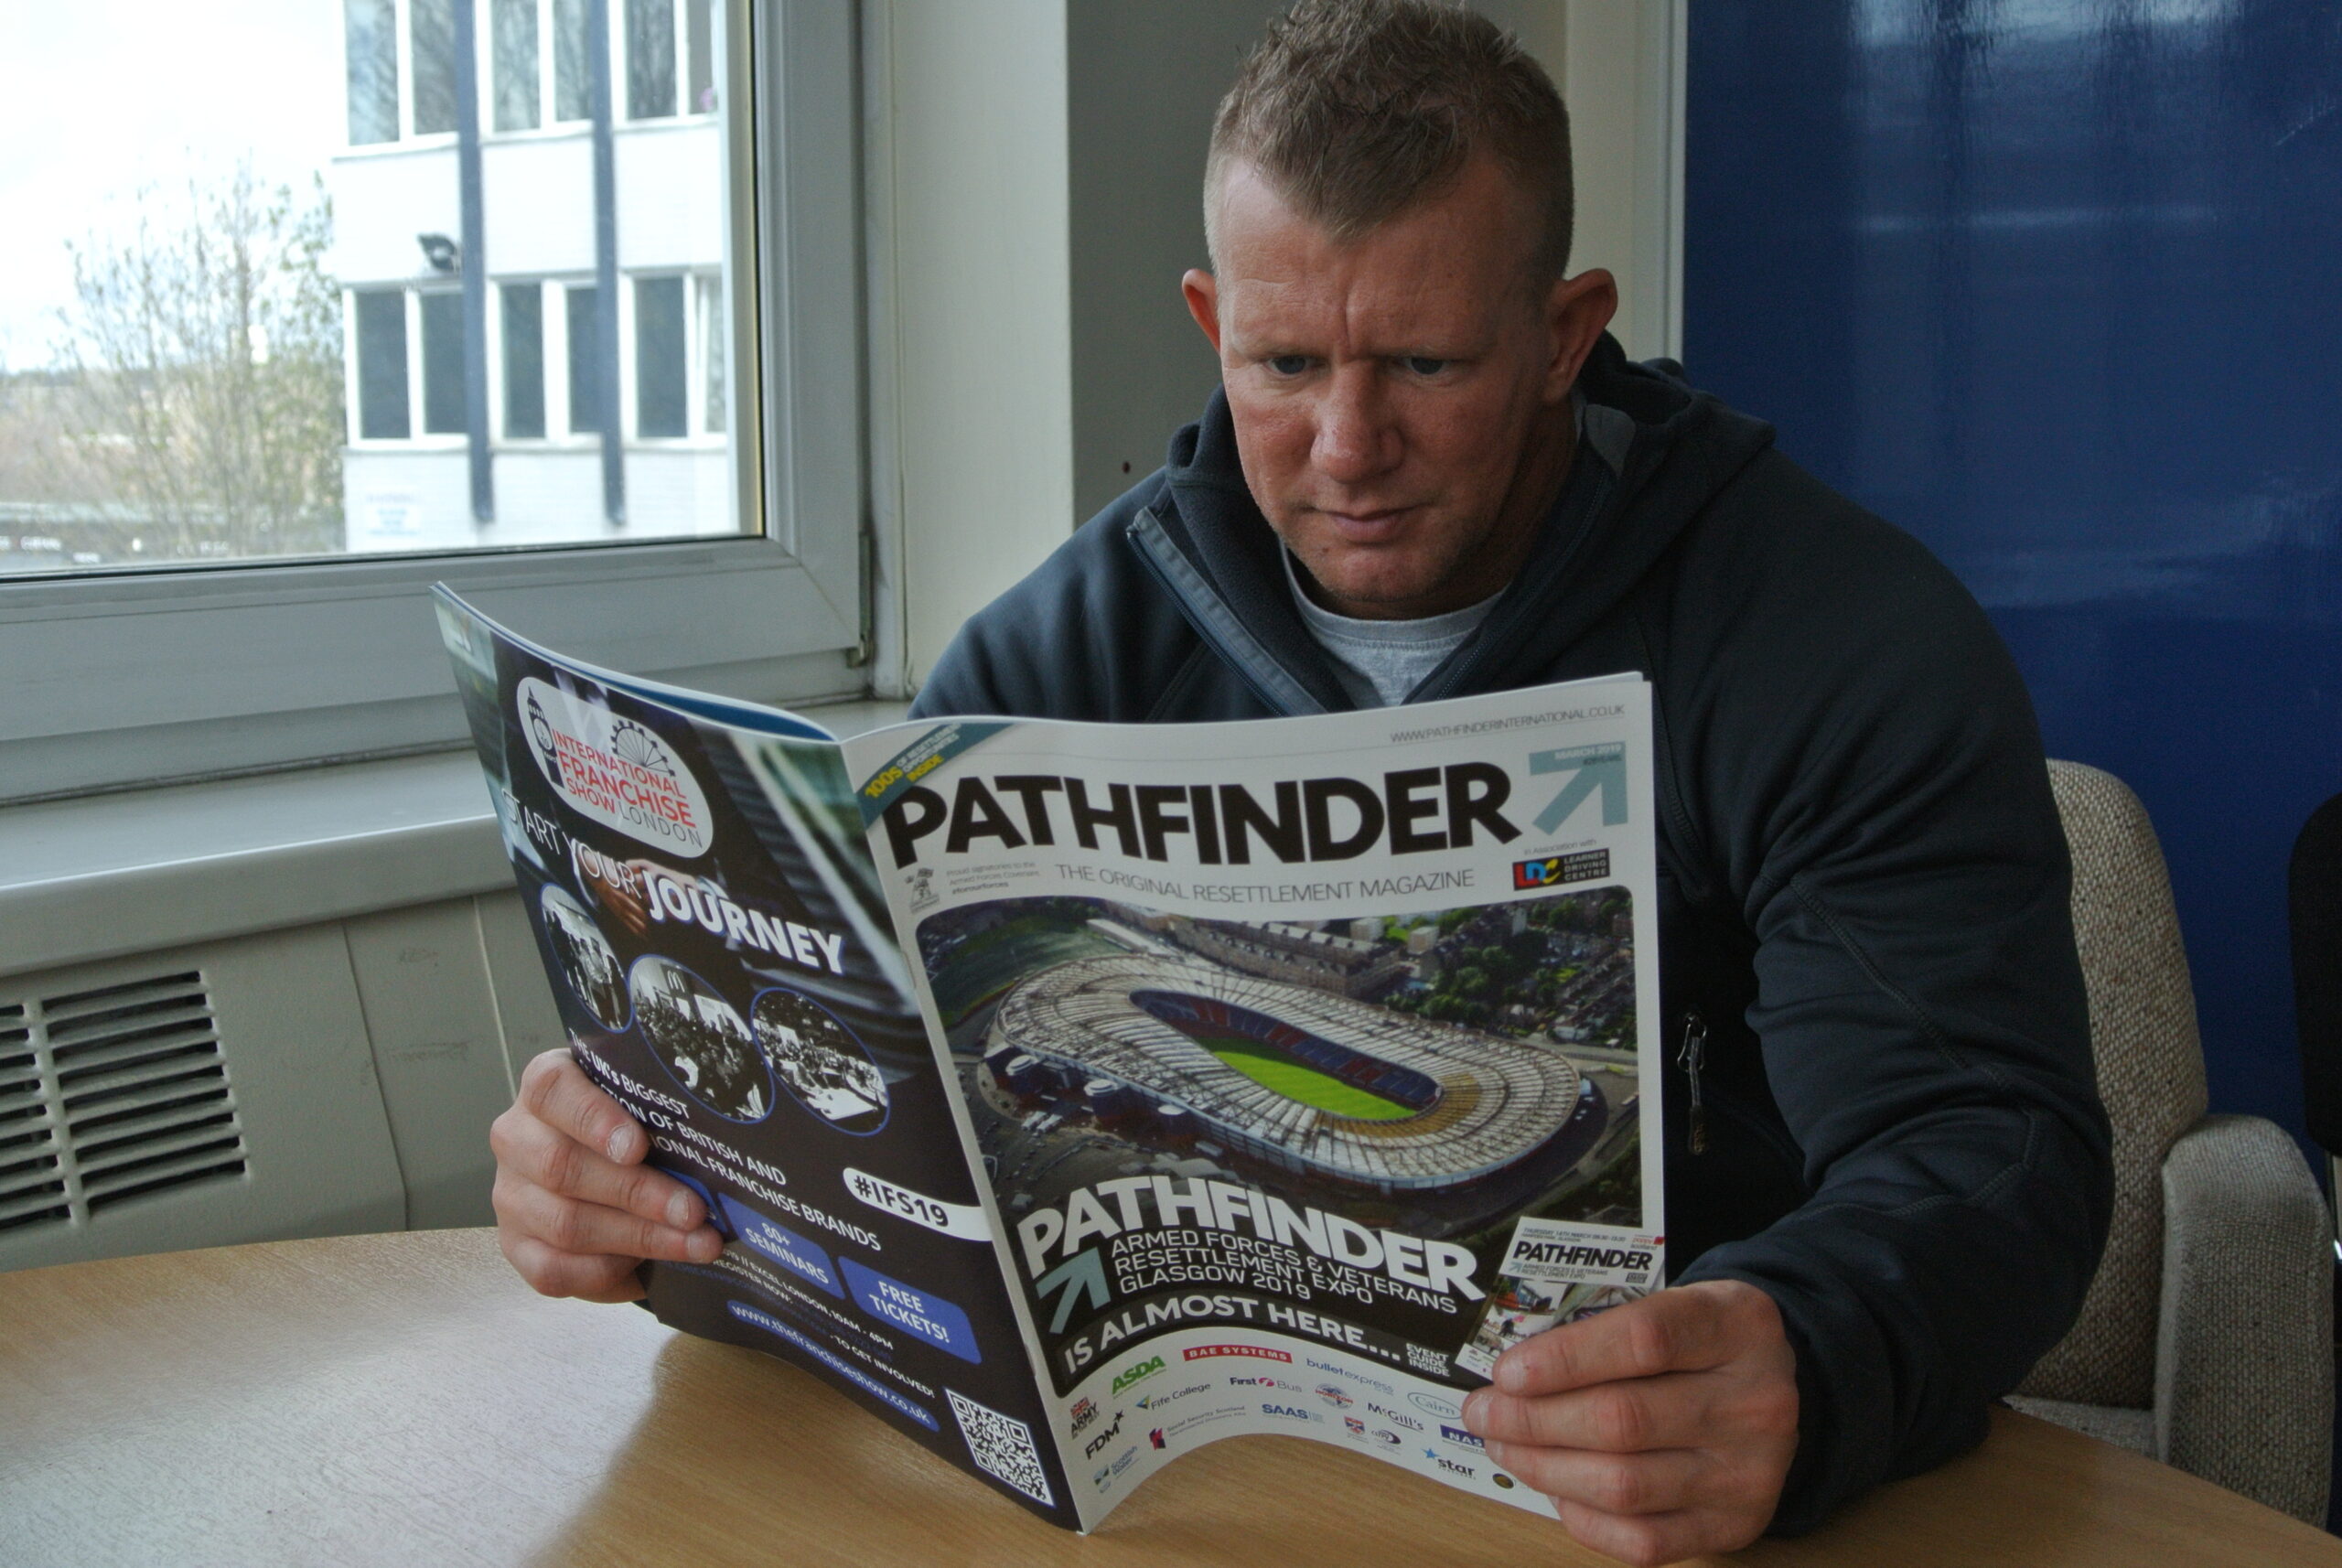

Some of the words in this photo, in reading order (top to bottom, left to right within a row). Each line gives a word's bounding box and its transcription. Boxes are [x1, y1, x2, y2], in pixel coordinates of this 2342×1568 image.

[1391, 703, 1625, 743] WWW.PATHFINDERINTERNATIONAL.CO.UK
[552, 728, 687, 800] INTERNATIONAL
[557, 751, 696, 828] FRANCHISE
[566, 778, 615, 814] SHOW
[618, 800, 703, 849] LONDON
[881, 761, 1522, 871] PATHFINDER
[501, 788, 561, 855] START
[562, 831, 642, 899] YOUR
[1563, 851, 1606, 865] LEARNER
[1055, 864, 1096, 882] THE
[1099, 868, 1187, 900] ORIGINAL
[1193, 880, 1353, 904] RESETTLEMENT
[1359, 869, 1476, 898] MAGAZINE
[1563, 859, 1607, 873] DRIVING
[1563, 868, 1607, 881] CENTRE
[642, 870, 843, 975] JOURNEY
[620, 1073, 690, 1120] BIGGEST
[650, 1111, 674, 1131] OF
[677, 1121, 744, 1166] BRITISH
[747, 1155, 787, 1186] AND
[706, 1156, 804, 1217] FRANCHISE
[800, 1203, 882, 1251] BRANDS
[854, 1175, 949, 1228] #IFS19
[761, 1222, 790, 1246] 80+
[1016, 1175, 1487, 1301] PATHFINDER
[745, 1228, 829, 1284] SEMINARS
[1112, 1230, 1199, 1258] ARMED
[1205, 1231, 1302, 1266] FORCES
[1306, 1255, 1323, 1273] &
[1327, 1262, 1457, 1314] VETERANS
[1513, 1240, 1653, 1271] PATHFINDER
[1114, 1248, 1305, 1283] RESETTLEMENT
[1311, 1273, 1372, 1304] EXPO
[1120, 1264, 1245, 1294] GLASGOW
[1252, 1272, 1311, 1300] 2019
[878, 1280, 925, 1314] FREE
[868, 1294, 951, 1344] TICKETS!
[1064, 1337, 1093, 1374] IS
[1101, 1294, 1260, 1352] ALMOST
[1267, 1303, 1401, 1361] HERE...
[731, 1305, 931, 1425] www.thefranchiseshow.co.uk
[1189, 1347, 1217, 1359] BAE
[1221, 1346, 1288, 1361] SYSTEMS
[1406, 1343, 1449, 1361] EVENT
[1407, 1351, 1446, 1369] GUIDE
[1409, 1359, 1451, 1377] INSIDE
[851, 1346, 872, 1363] GET
[874, 1359, 935, 1399] INVOLVED!
[1112, 1355, 1166, 1394] ASDA
[1230, 1377, 1257, 1387] First
[1277, 1380, 1303, 1392] Bus
[1306, 1358, 1394, 1392] bulletexpress
[1151, 1396, 1171, 1411] Fife
[1172, 1383, 1211, 1400] College
[1262, 1403, 1309, 1419] SAAS
[1414, 1395, 1456, 1416] Cairn
[1071, 1402, 1098, 1435] ARMY
[1368, 1402, 1424, 1431] McGill's
[1085, 1422, 1120, 1460] FDM
[1449, 1432, 1483, 1447] NAS
[1437, 1458, 1476, 1477] star
